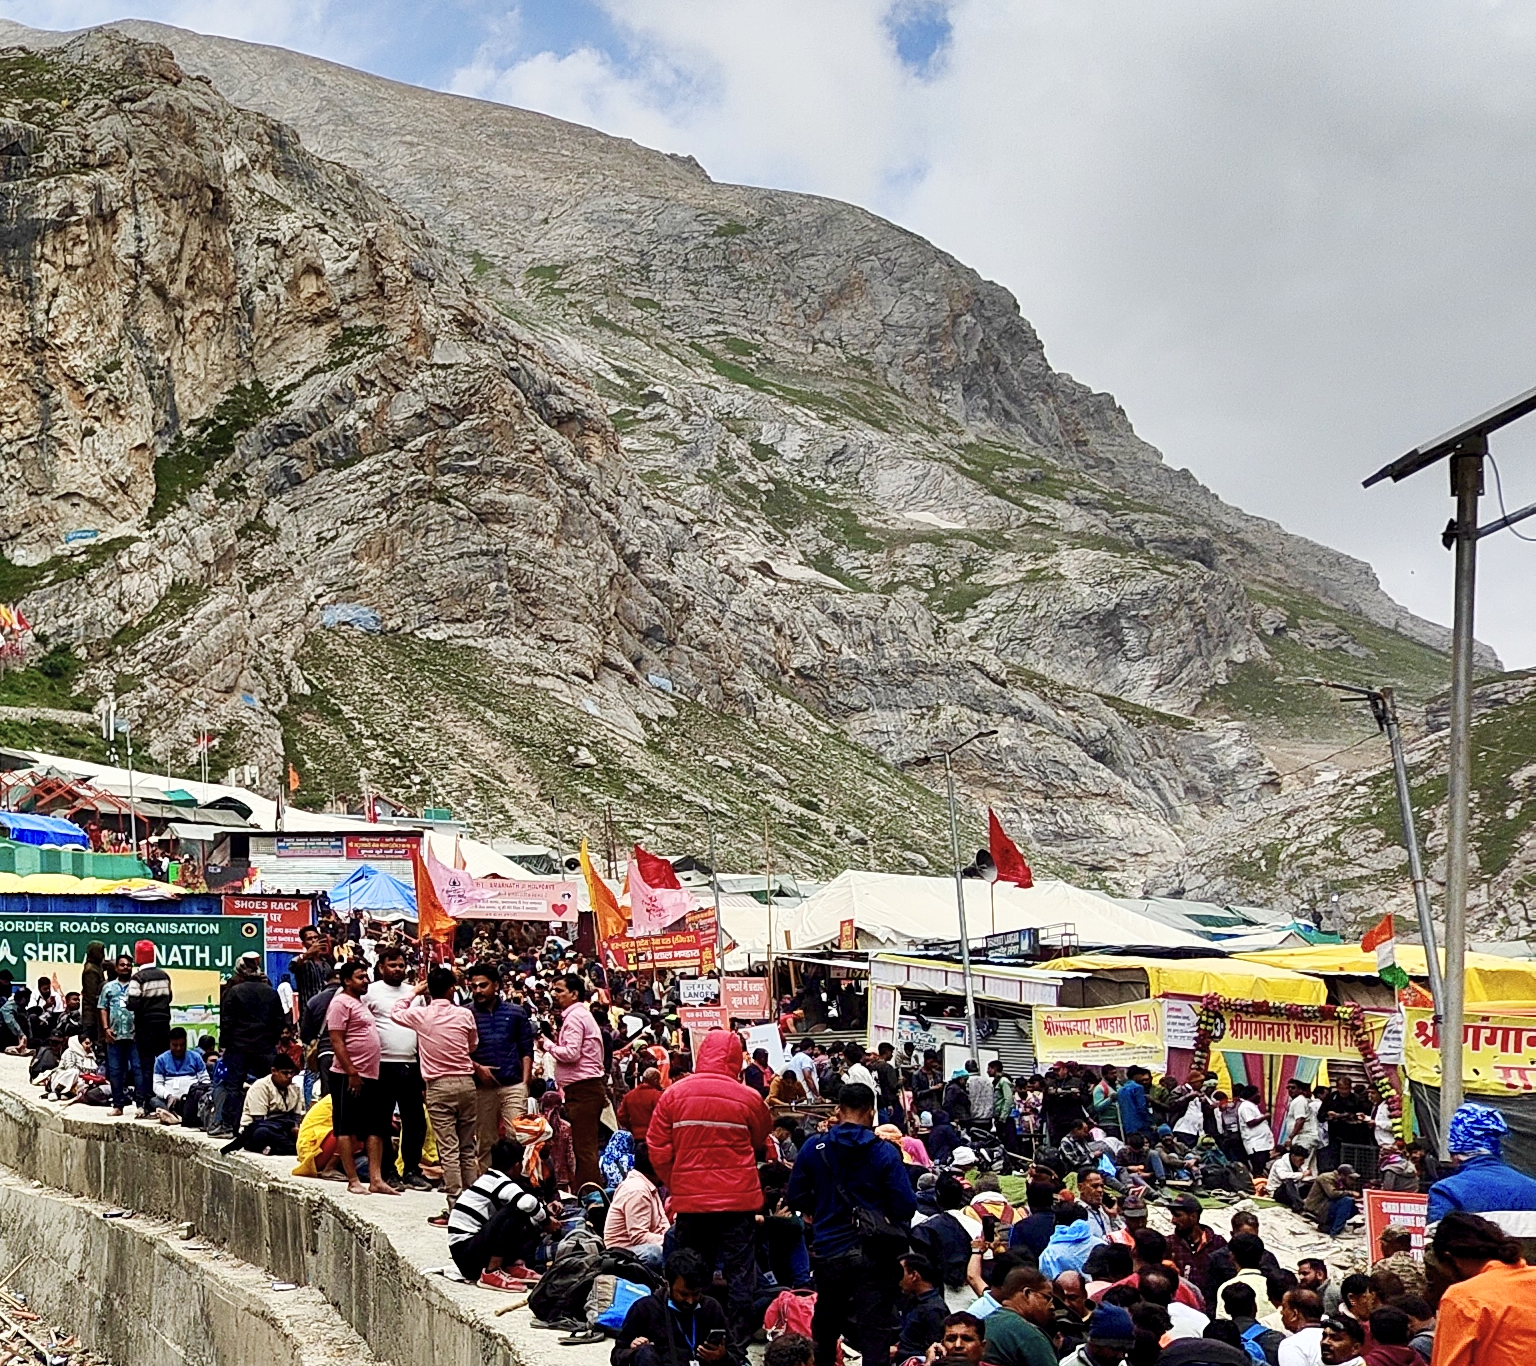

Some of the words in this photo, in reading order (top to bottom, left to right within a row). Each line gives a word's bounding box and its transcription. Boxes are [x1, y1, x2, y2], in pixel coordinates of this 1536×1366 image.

[234, 900, 268, 909] SHOES
[270, 901, 298, 911] RACK
[60, 922, 109, 933] ROADS
[115, 922, 219, 935] ORGANISATION
[23, 943, 75, 964] SHRI
[214, 946, 232, 967] JI
